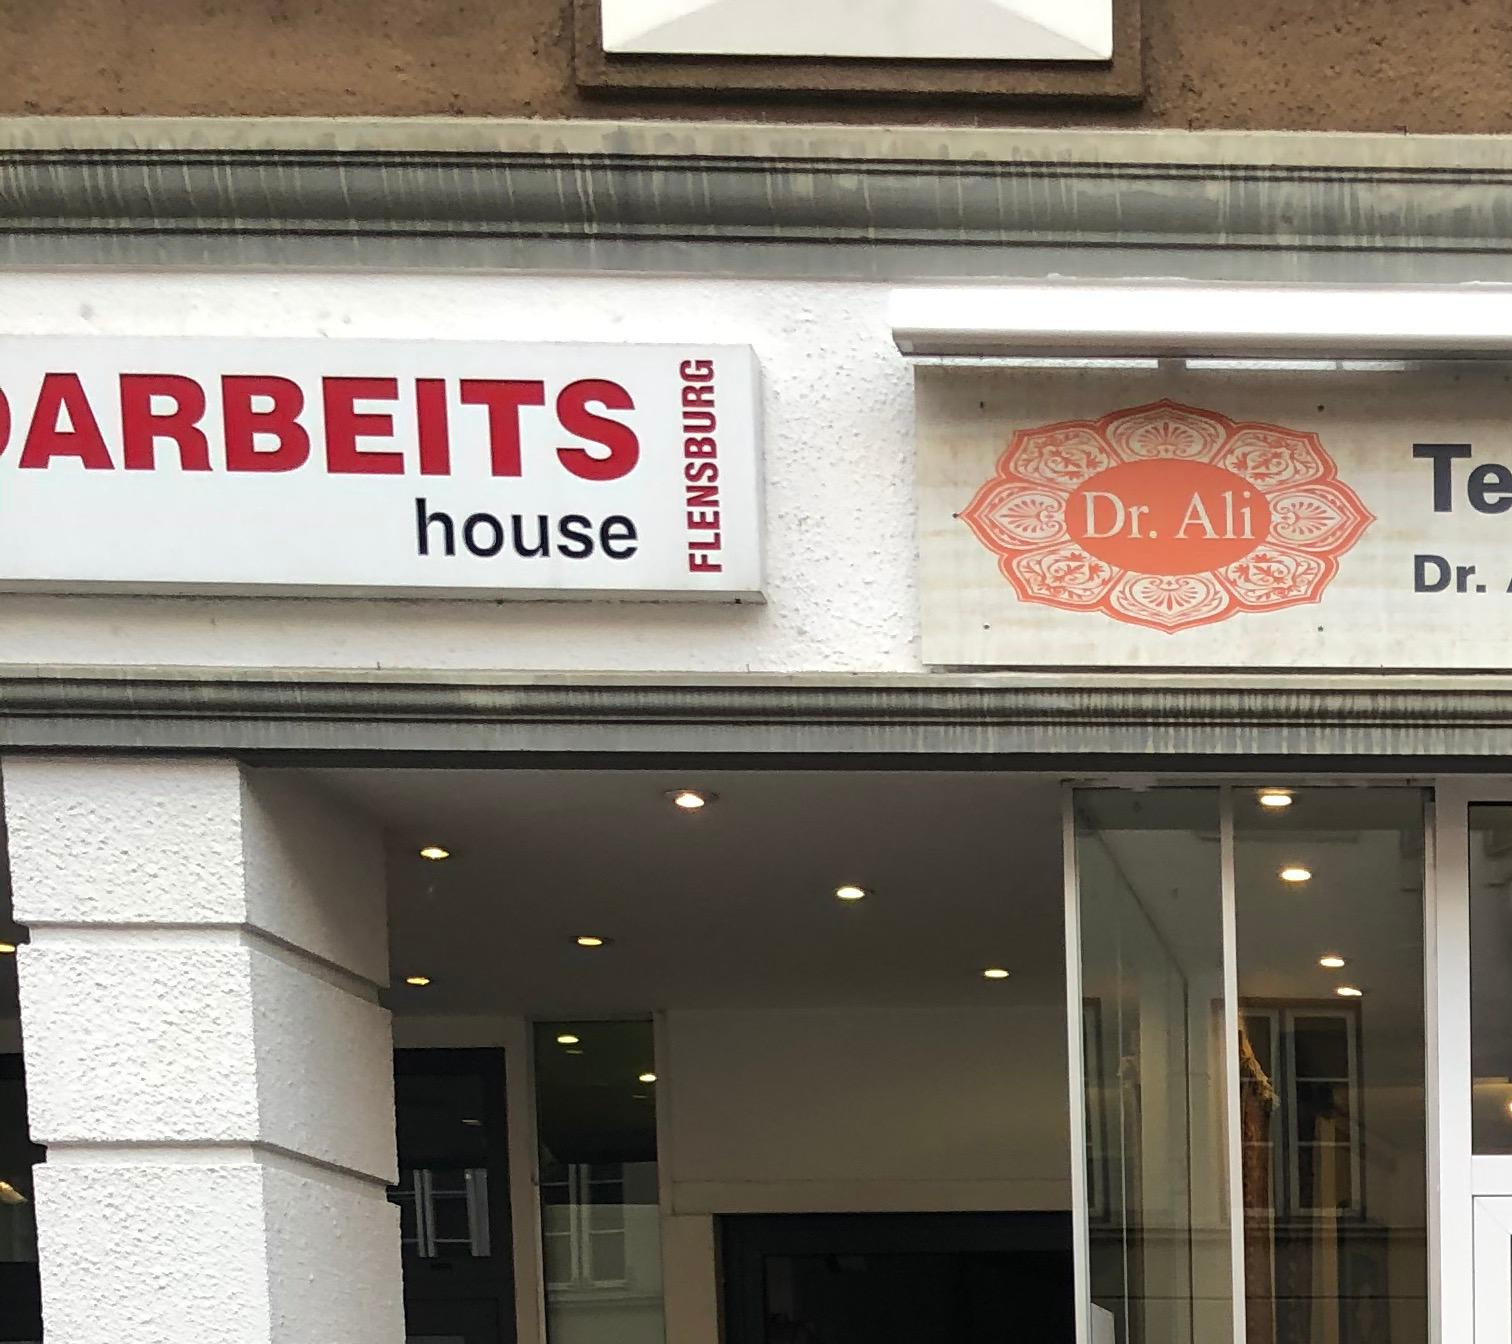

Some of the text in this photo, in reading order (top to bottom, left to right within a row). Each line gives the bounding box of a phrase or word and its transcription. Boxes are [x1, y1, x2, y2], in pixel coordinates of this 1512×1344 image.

[0, 372, 640, 481] ARBEITS
[679, 359, 722, 573] FLENSBURG
[415, 497, 638, 560] house
[1083, 490, 1255, 540] Dr. Ali
[1414, 554, 1487, 593] Dr.
